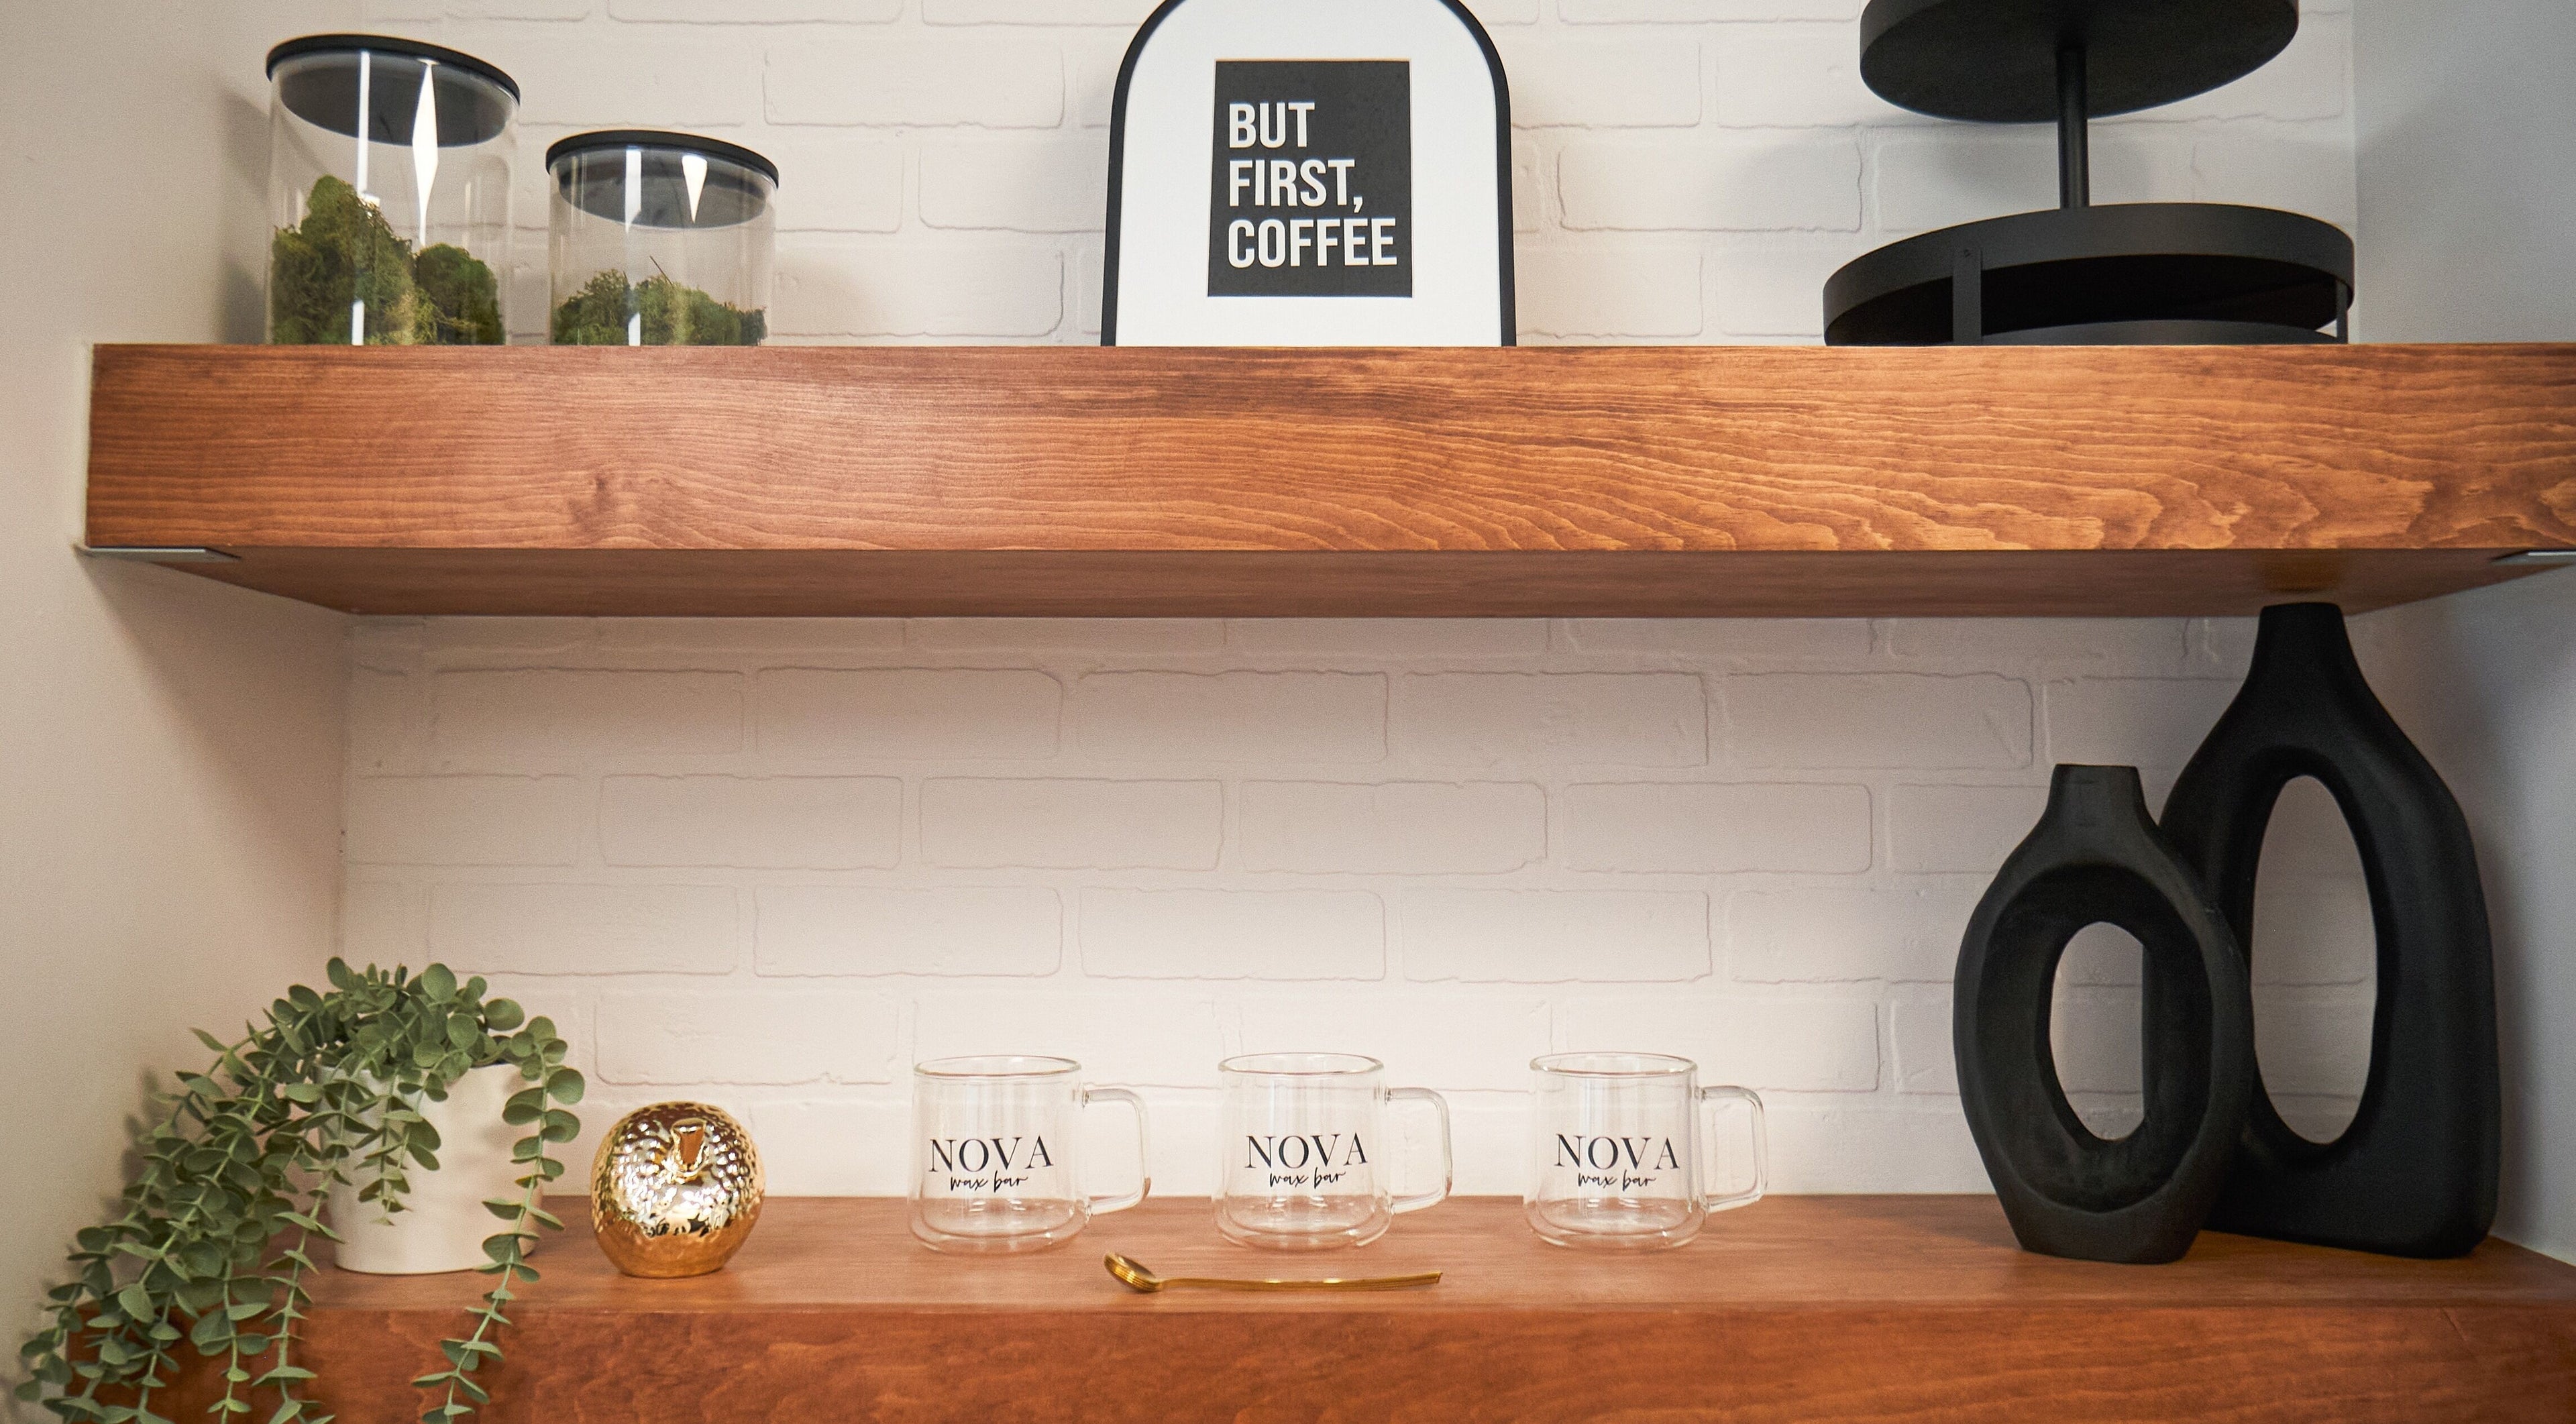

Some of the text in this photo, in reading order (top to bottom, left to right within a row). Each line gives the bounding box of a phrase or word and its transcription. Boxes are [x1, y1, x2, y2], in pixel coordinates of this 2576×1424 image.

[1228, 101, 1316, 149] BUT
[1228, 158, 1364, 213] FIRST,
[1228, 217, 1398, 268] COFFEE
[928, 1136, 1054, 1172] NOVA
[1244, 1132, 1368, 1169] NOVA
[1554, 1134, 1680, 1170] NOVA
[950, 1170, 1028, 1193] wax bar
[1269, 1167, 1346, 1189] wax bar
[1577, 1169, 1657, 1192] wax bar
